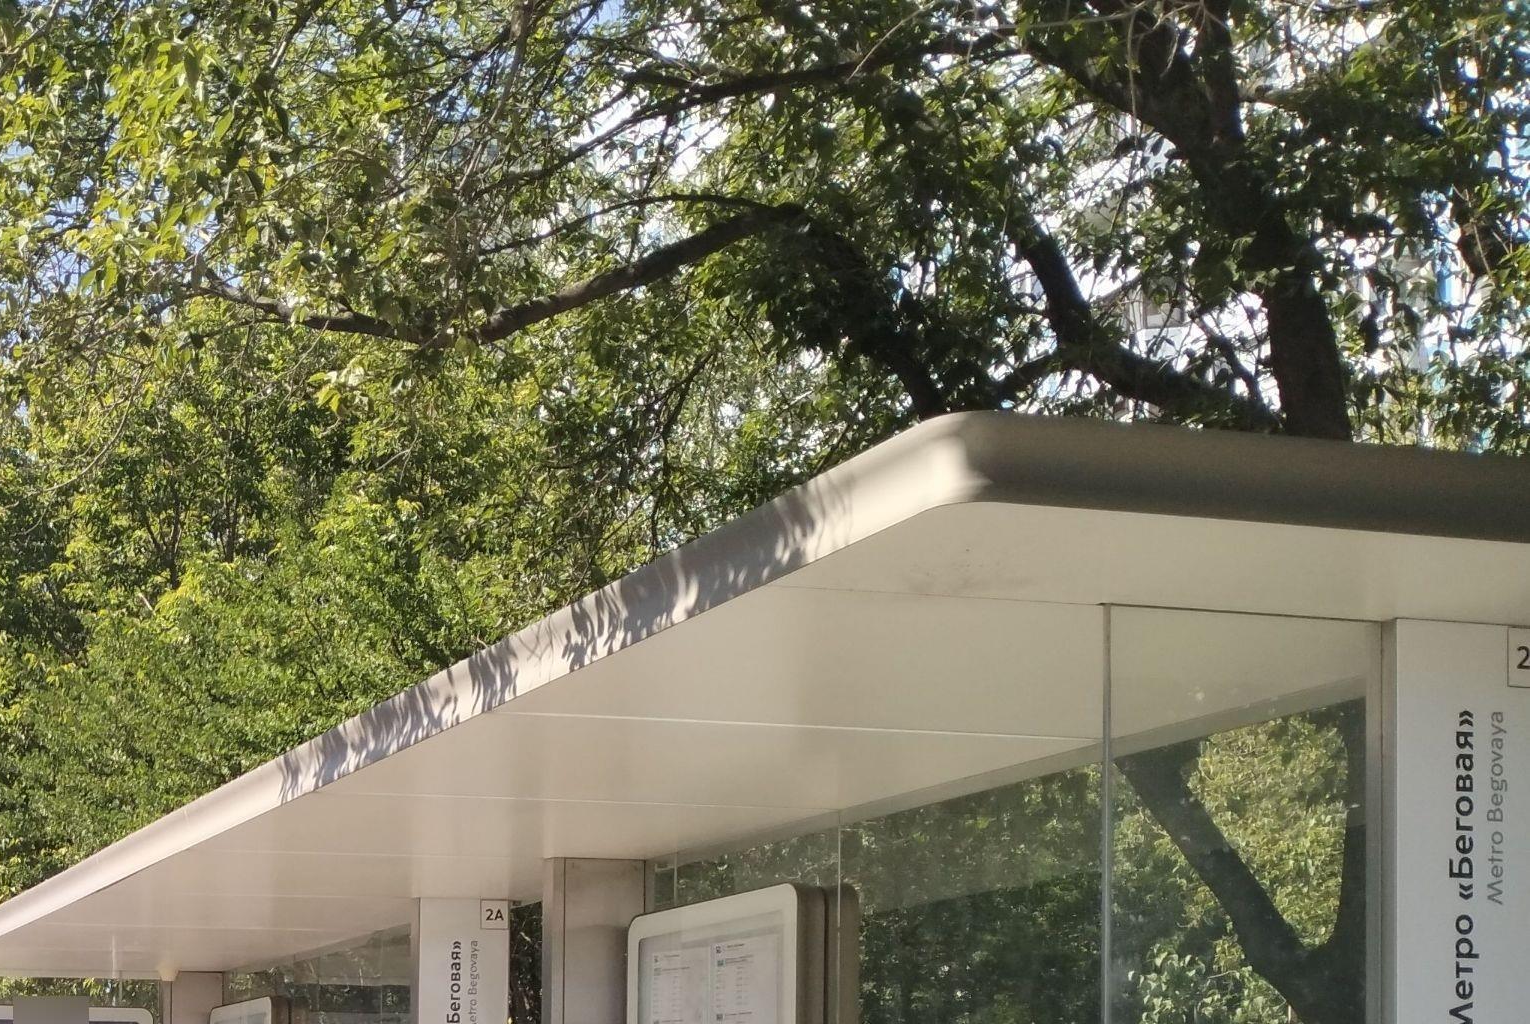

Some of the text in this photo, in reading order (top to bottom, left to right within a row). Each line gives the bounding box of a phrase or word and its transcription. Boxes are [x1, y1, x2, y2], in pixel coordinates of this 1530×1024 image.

[1516, 645, 1530, 670] 2
[1448, 710, 1475, 901] «Беговая»
[1487, 711, 1508, 906] Metro Begovaya
[468, 941, 480, 995] Begovaya
